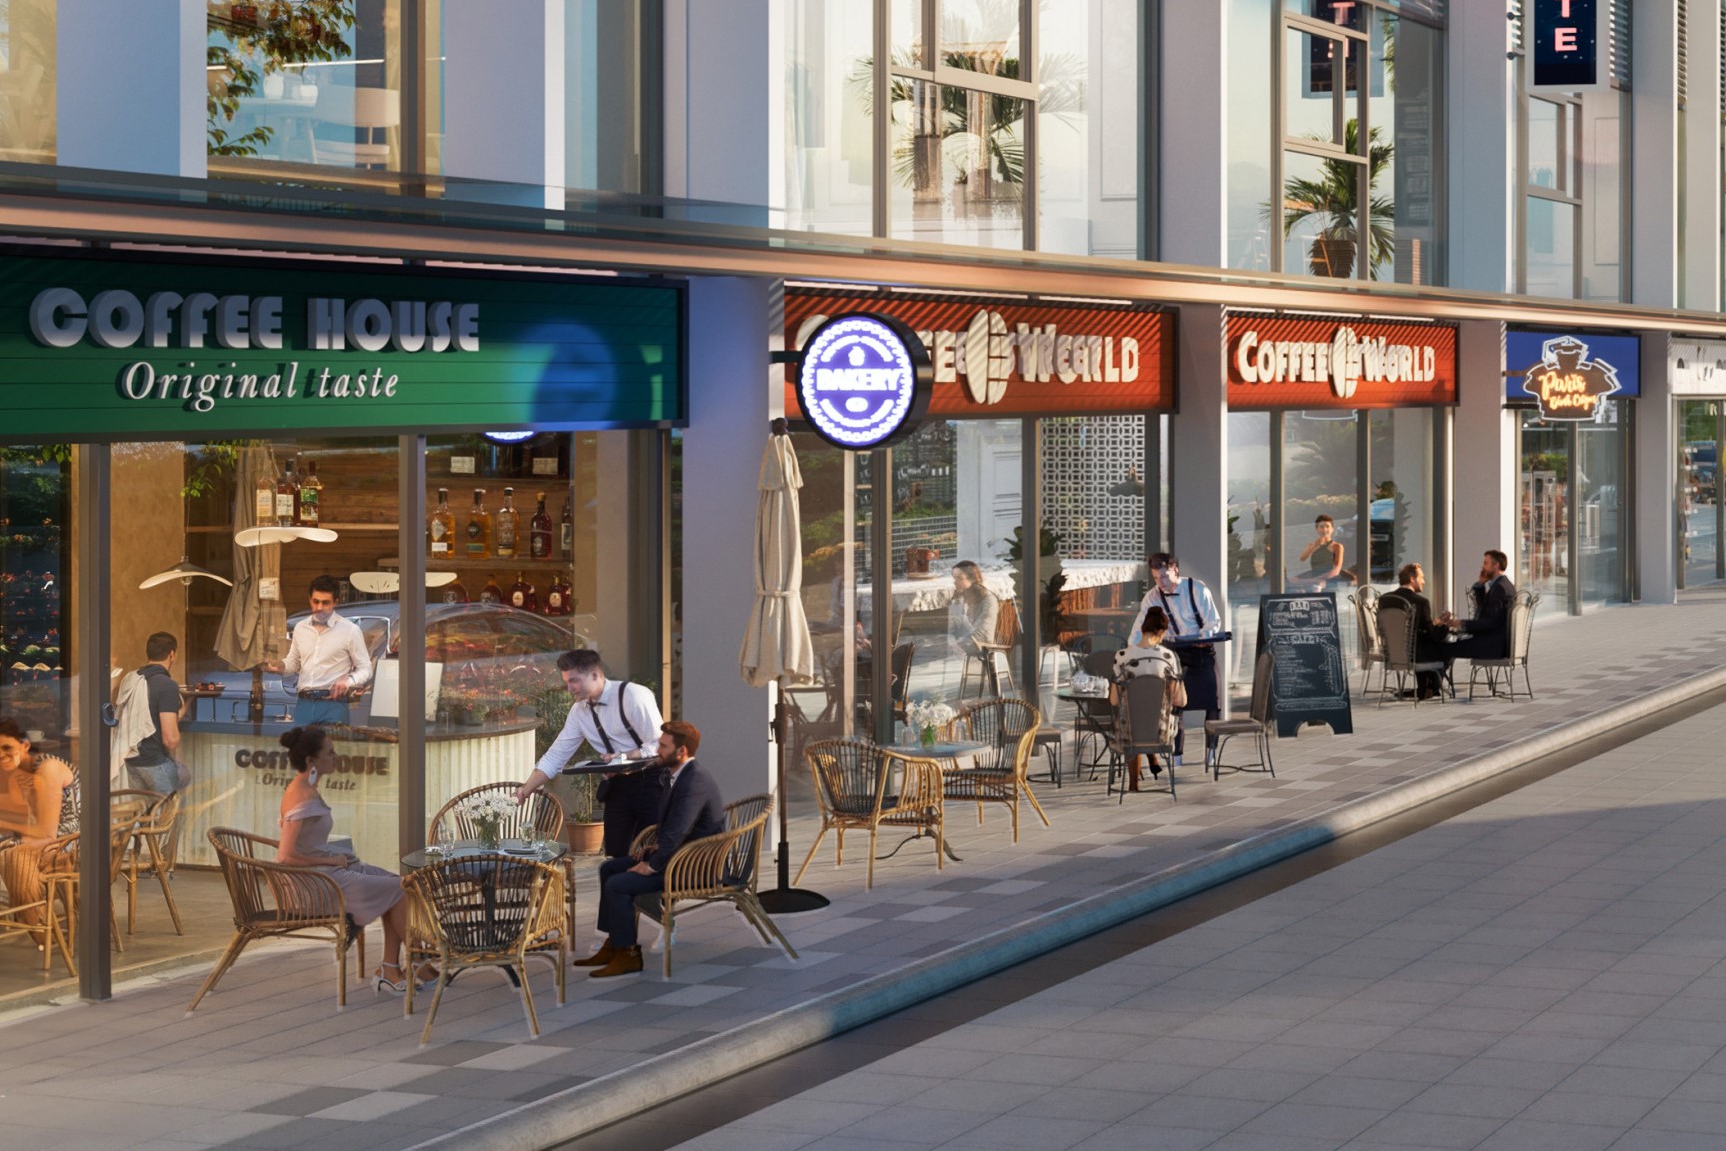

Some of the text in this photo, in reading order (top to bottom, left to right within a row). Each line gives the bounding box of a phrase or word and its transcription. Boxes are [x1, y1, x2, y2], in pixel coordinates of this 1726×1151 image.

[29, 287, 480, 352] COFFEE HOUSE
[123, 361, 400, 411] Original taste
[816, 368, 902, 391] BAKERY
[1538, 371, 1586, 401] Paris
[326, 778, 356, 791] taste
